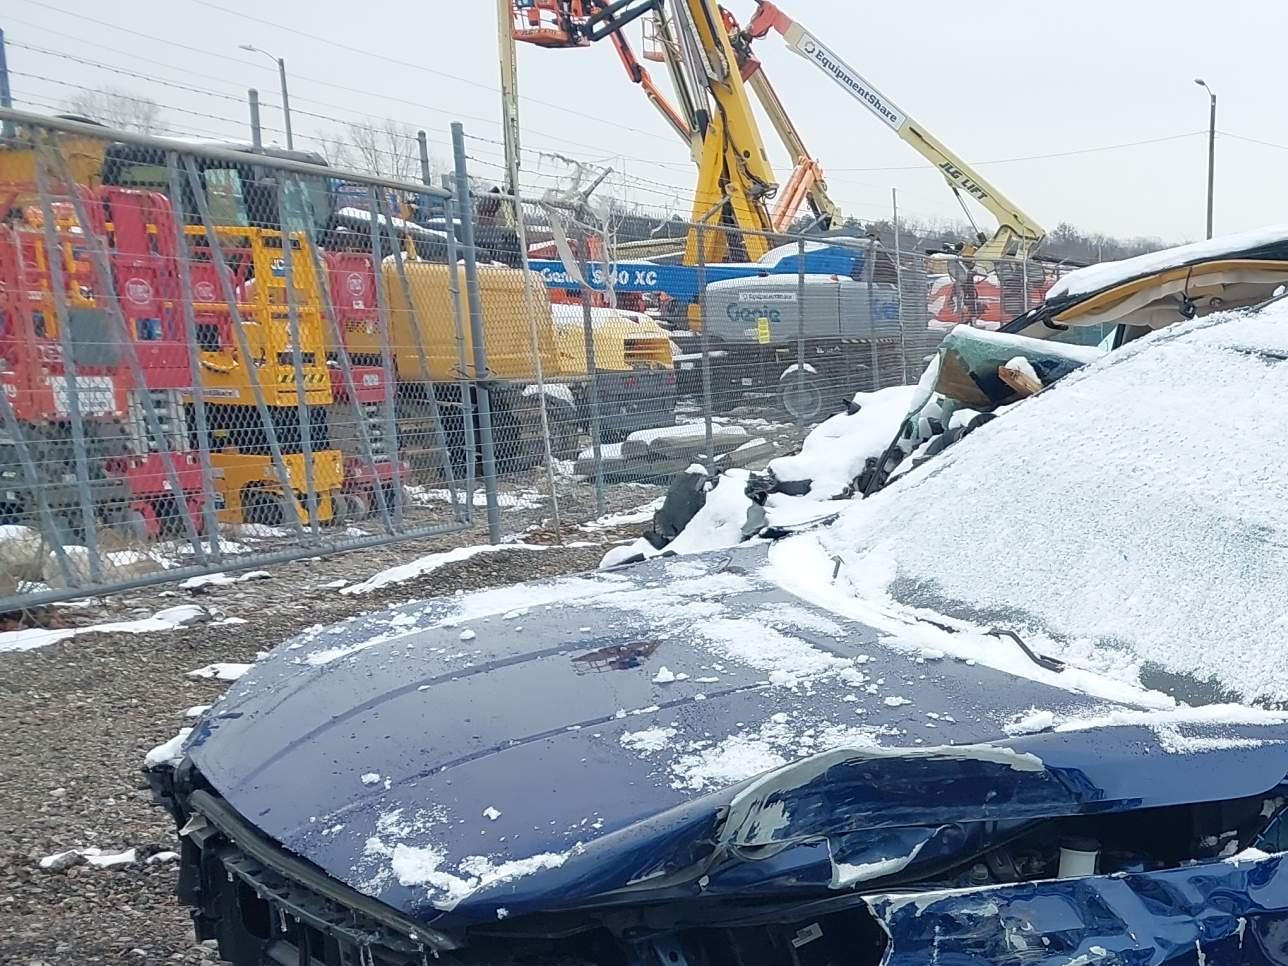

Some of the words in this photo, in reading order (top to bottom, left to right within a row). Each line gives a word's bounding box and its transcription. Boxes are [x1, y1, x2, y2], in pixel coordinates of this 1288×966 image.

[815, 50, 897, 123] EquipmentShare
[938, 161, 962, 180] JLG
[961, 178, 989, 201] LIFT
[633, 270, 658, 286] XC
[726, 302, 782, 323] Genie
